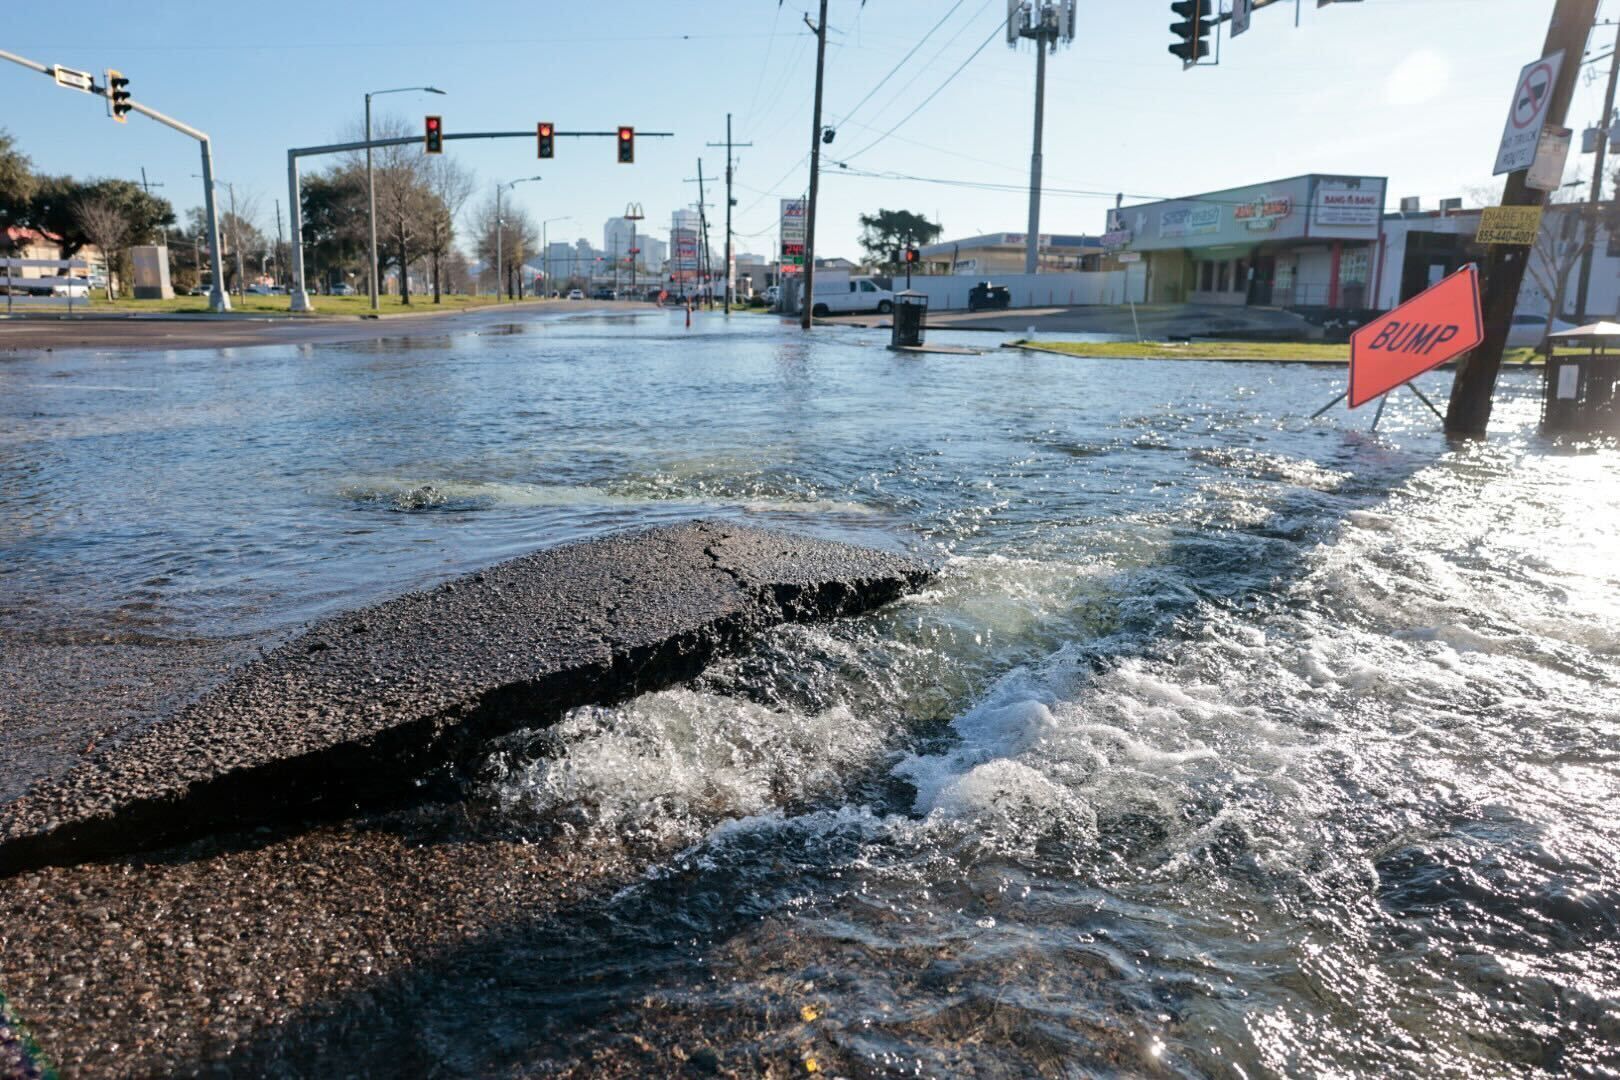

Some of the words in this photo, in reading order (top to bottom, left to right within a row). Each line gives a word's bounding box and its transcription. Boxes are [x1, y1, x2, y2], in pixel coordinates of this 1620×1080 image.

[1514, 130, 1538, 145] TRUCK
[1483, 210, 1539, 222] DIABETIC
[1480, 221, 1535, 231] SUES
[1478, 229, 1537, 243] 855-440-4001
[1368, 321, 1459, 355] BUMP
